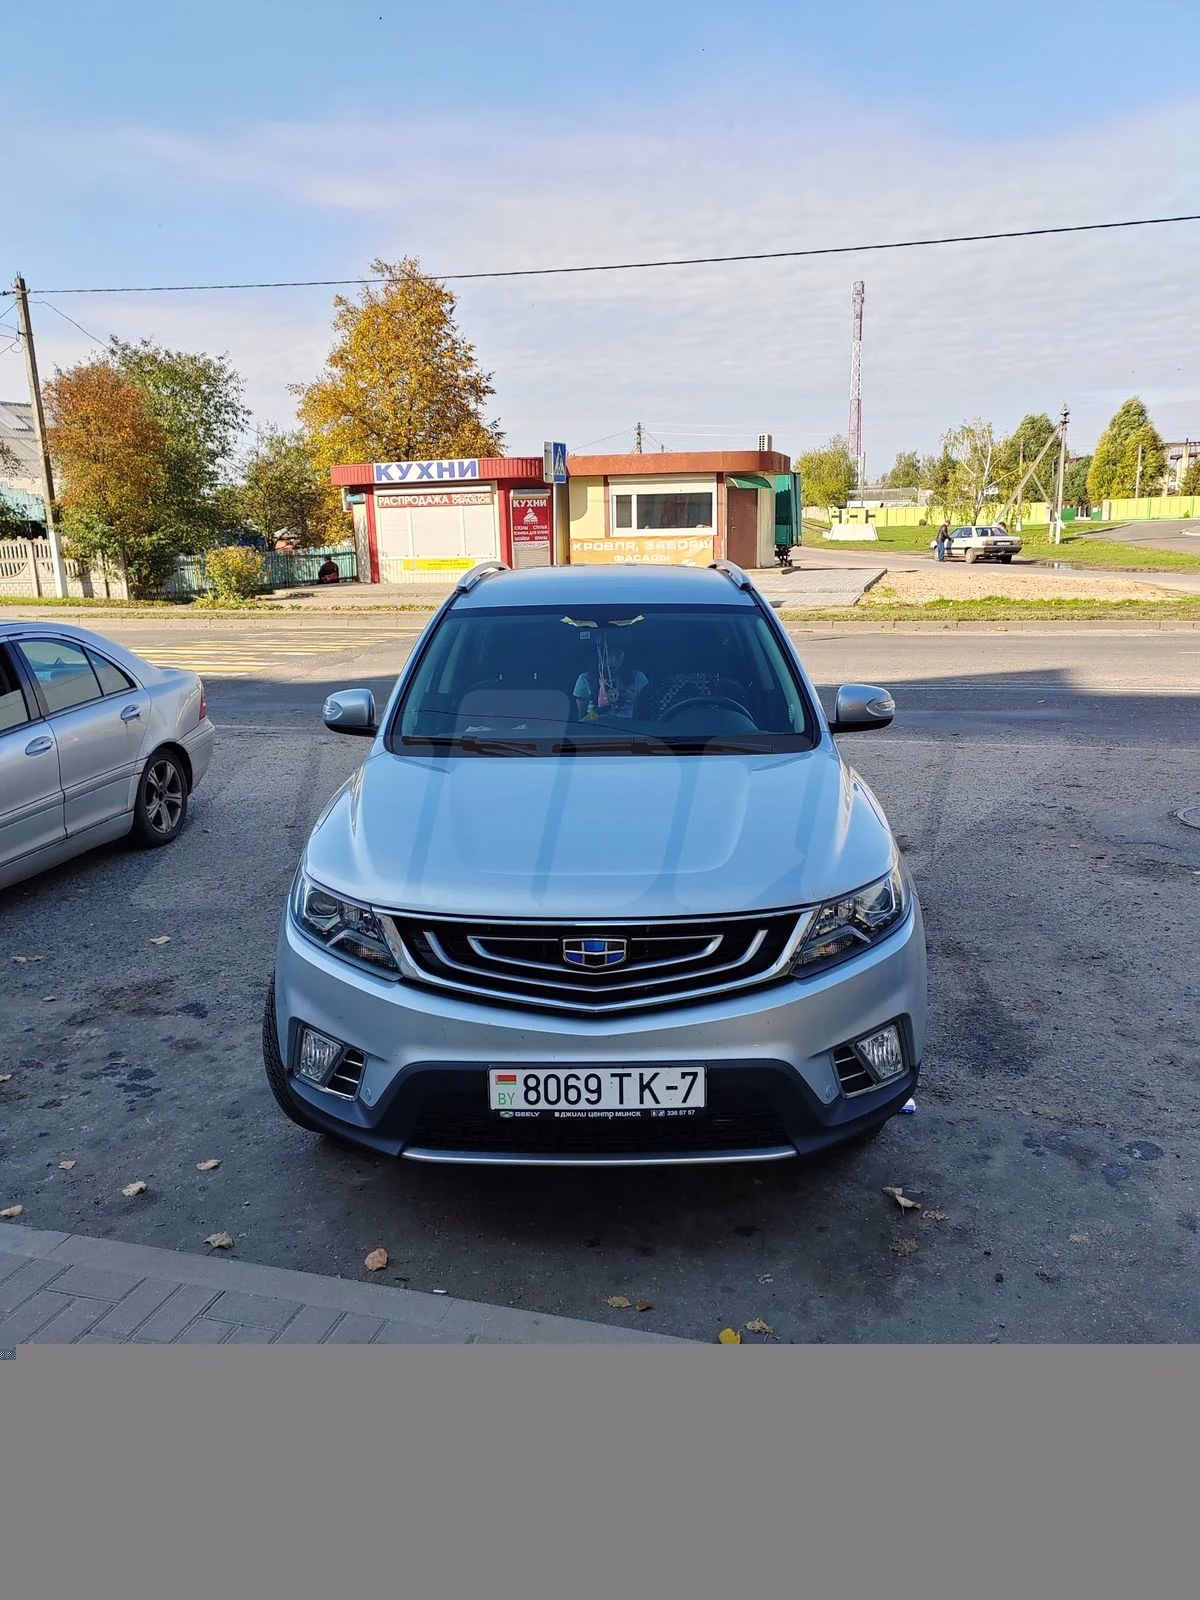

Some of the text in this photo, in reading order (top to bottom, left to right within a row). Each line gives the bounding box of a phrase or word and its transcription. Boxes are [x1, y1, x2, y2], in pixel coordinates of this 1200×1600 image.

[375, 461, 477, 481] КУХНИ
[378, 494, 450, 507] РАСПРОДАЖА
[513, 499, 547, 508] КУХНИ
[572, 539, 712, 551] КРОВЛЯ, ЗАБОРЫ
[613, 554, 670, 562] ФАСАДЫ
[498, 1093, 515, 1105] BY
[523, 1073, 602, 1106] 8069
